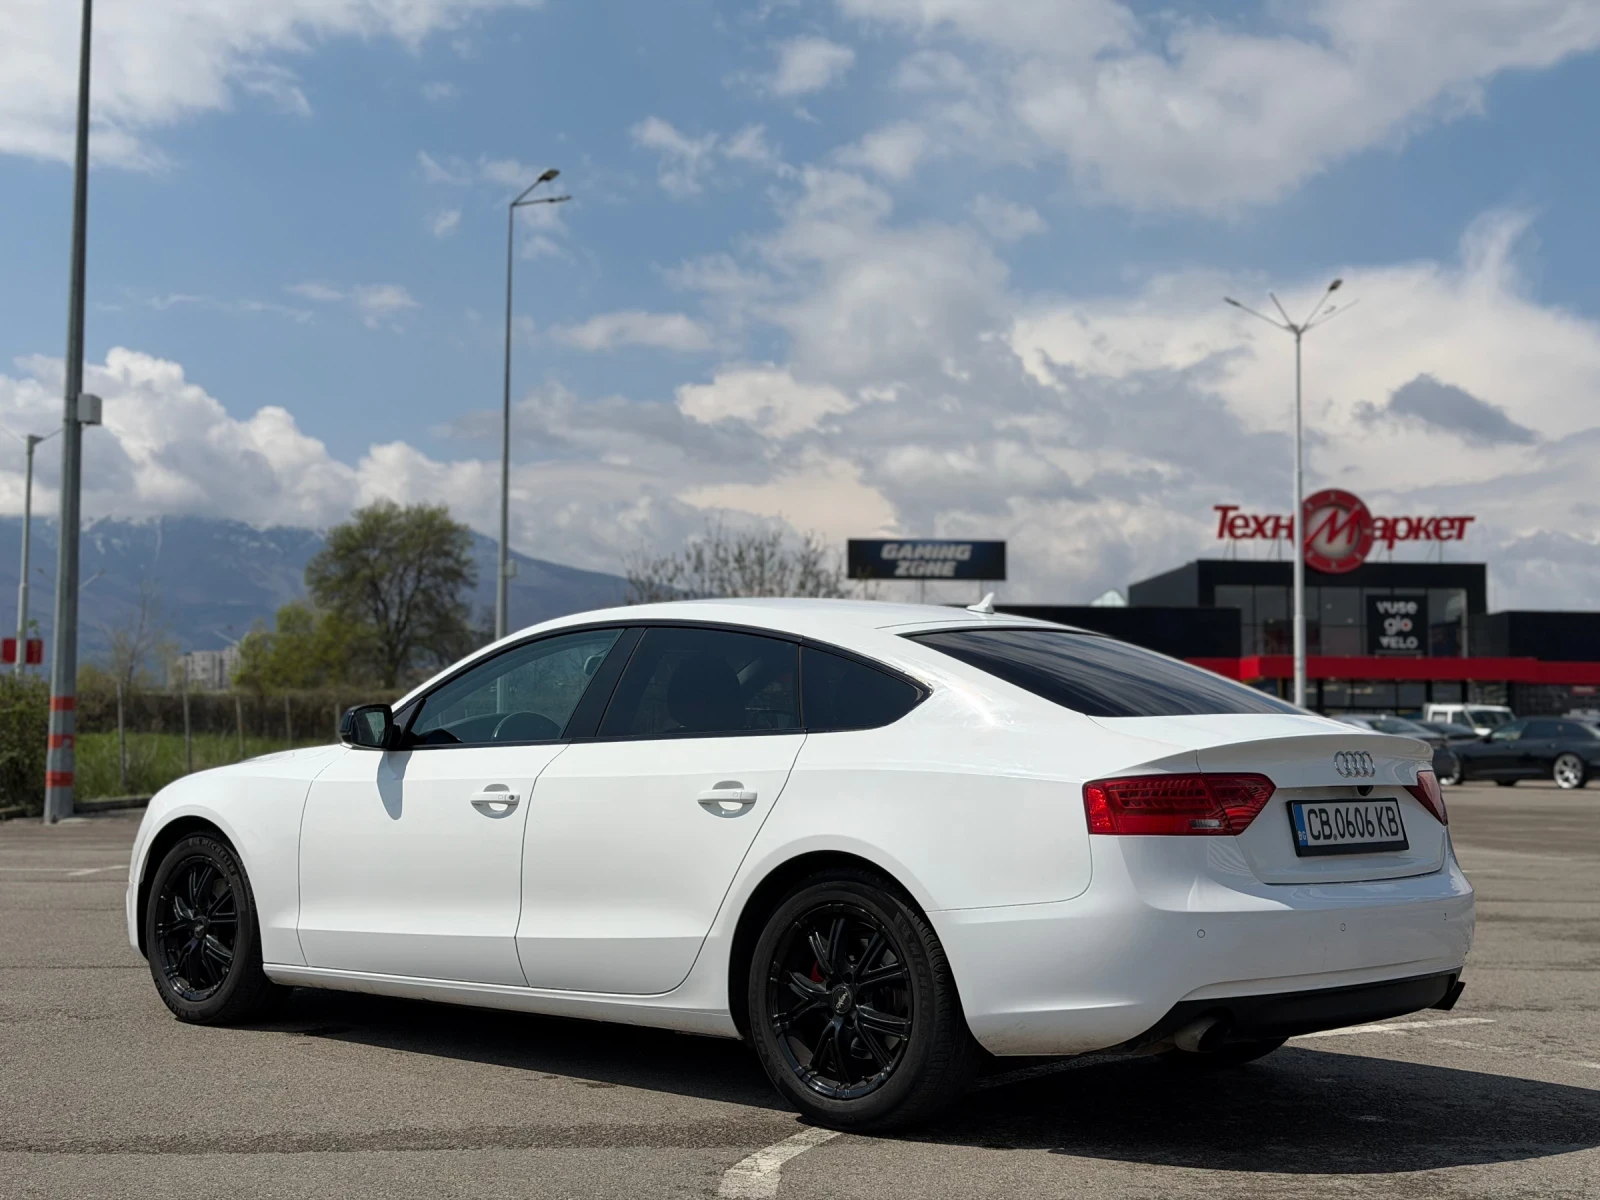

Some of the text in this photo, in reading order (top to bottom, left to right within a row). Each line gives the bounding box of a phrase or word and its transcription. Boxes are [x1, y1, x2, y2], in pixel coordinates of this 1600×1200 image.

[880, 543, 973, 560] GAMING
[894, 561, 957, 577] ZONE
[1383, 615, 1413, 636] glo
[1379, 636, 1418, 649] VELO
